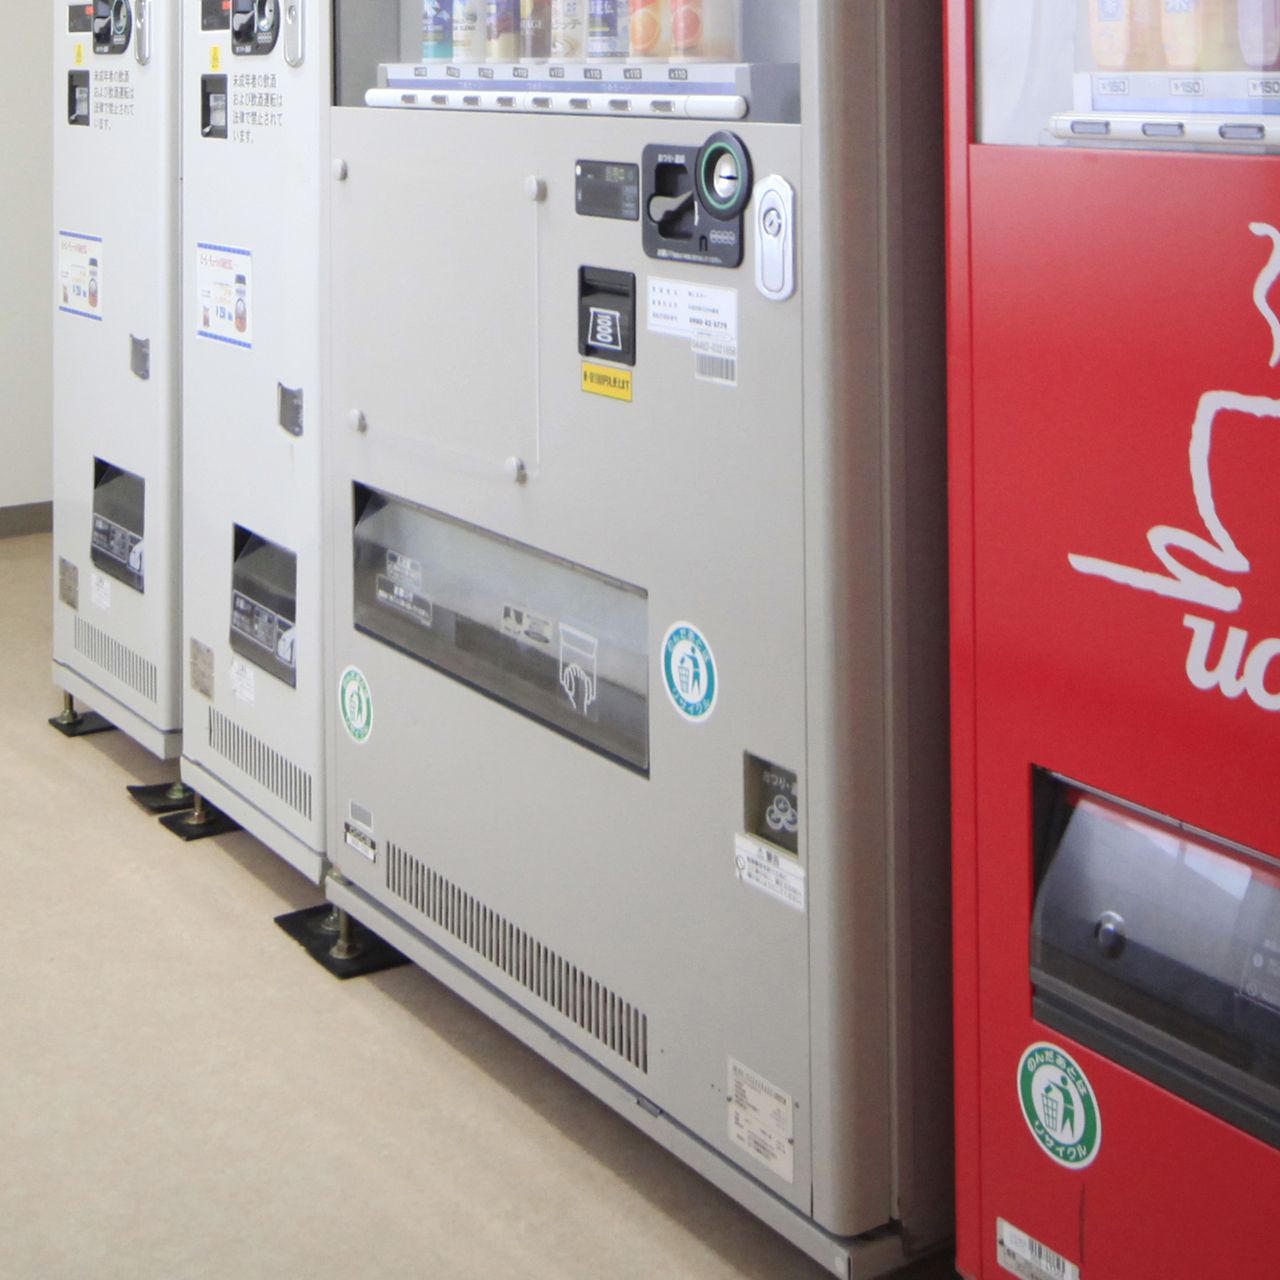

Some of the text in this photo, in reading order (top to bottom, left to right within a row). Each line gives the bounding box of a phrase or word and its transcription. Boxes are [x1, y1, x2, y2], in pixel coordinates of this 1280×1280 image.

[232, 73, 278, 88] 未成年者の飲酒
[1252, 81, 1280, 95] ¥150
[232, 92, 284, 108] および飲酒運転は
[232, 110, 284, 127] 法律で禁止されて
[232, 128, 255, 145] います。
[595, 313, 613, 343] 1000
[1026, 1049, 1088, 1097] のんだあとは
[1034, 1119, 1088, 1161] リサイクル
